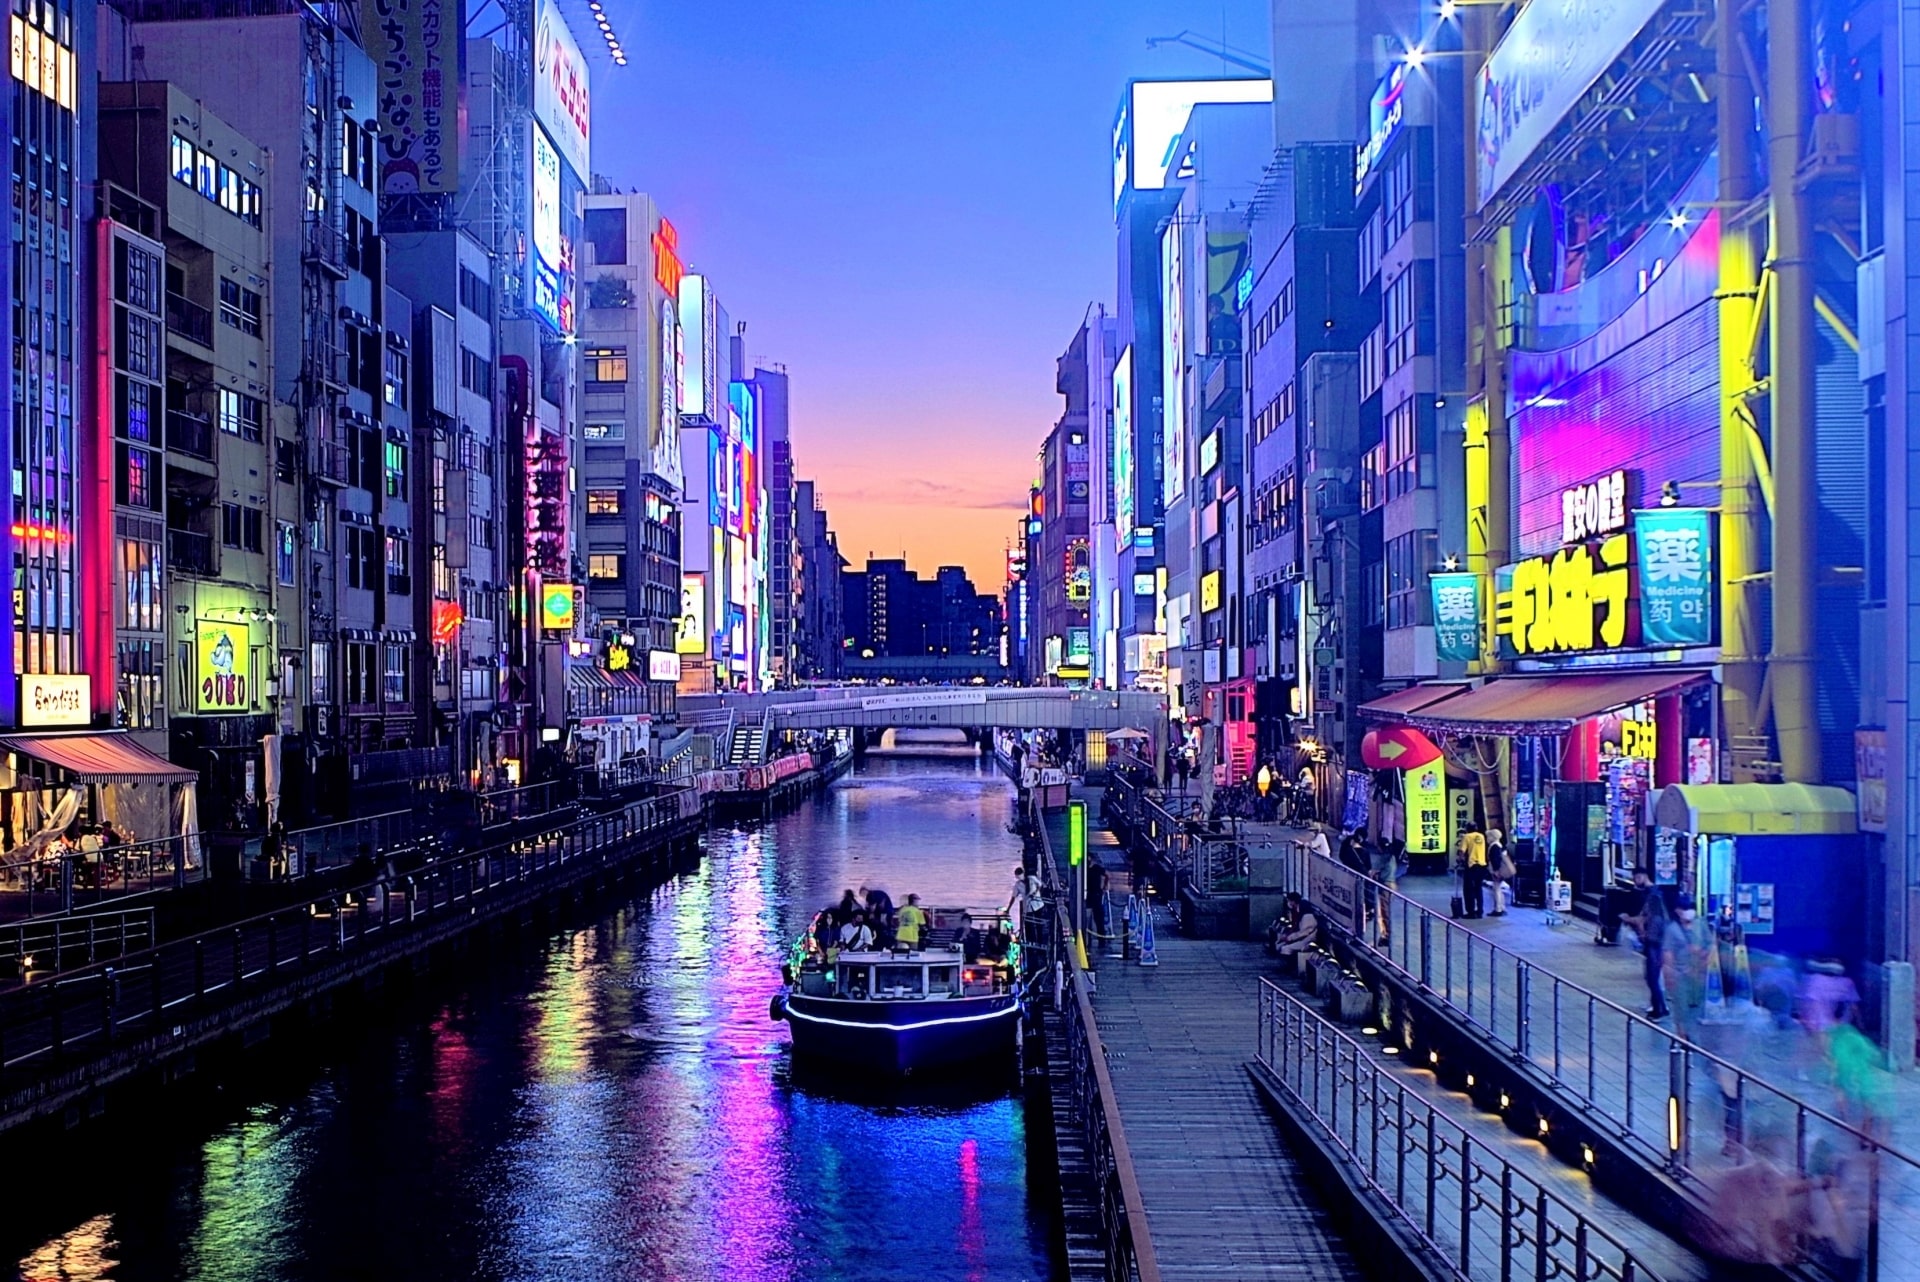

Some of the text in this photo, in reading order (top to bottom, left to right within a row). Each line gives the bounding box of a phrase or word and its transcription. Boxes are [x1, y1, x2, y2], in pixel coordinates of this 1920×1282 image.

[1561, 470, 1625, 543] 激安の殿堂
[1643, 528, 1702, 582] 薬
[1437, 585, 1476, 622] 薬
[1645, 586, 1704, 597] Medicine
[1648, 598, 1704, 624] 药 약
[1439, 623, 1477, 631] Medicine
[1460, 632, 1478, 649] 약
[1420, 808, 1441, 851] 観覧車
